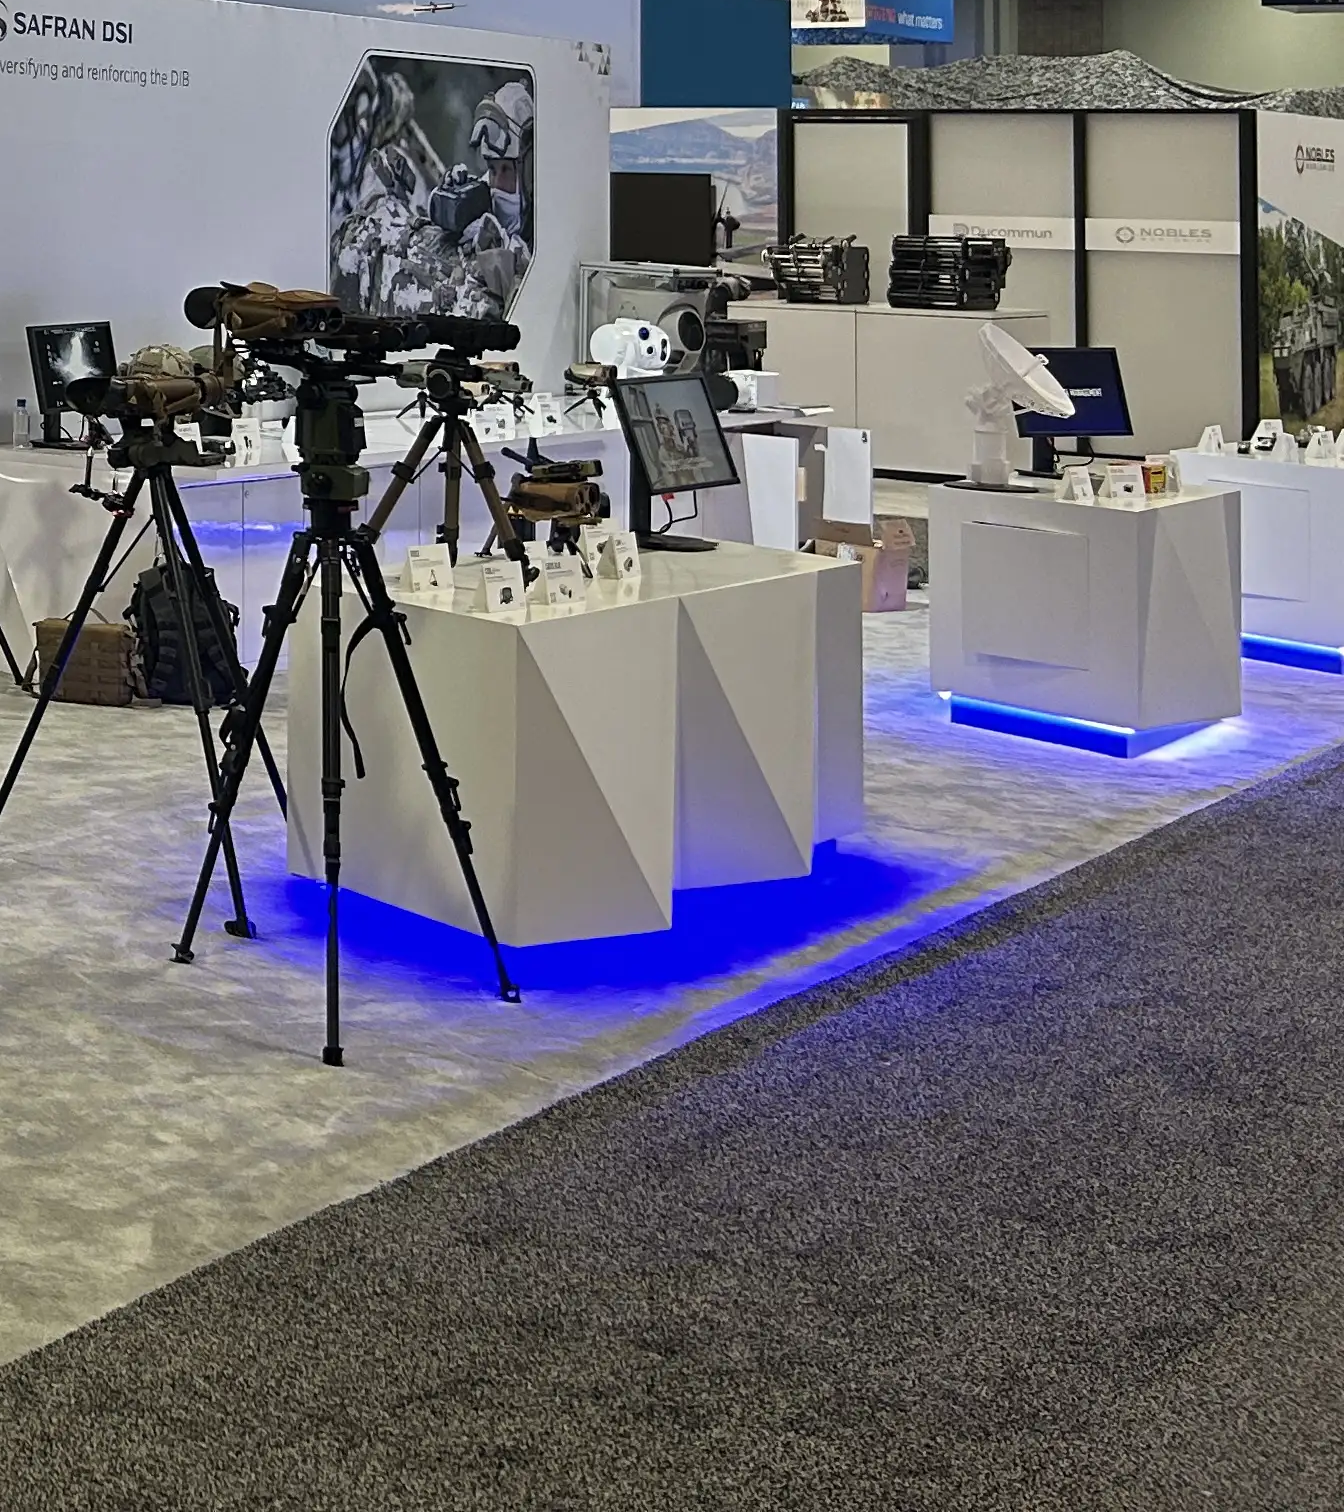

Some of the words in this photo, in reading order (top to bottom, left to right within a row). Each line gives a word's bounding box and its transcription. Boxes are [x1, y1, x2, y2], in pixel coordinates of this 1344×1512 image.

[13, 11, 95, 40] SAFRAN
[102, 20, 133, 44] DSI
[61, 62, 84, 80] and
[87, 63, 147, 87] reinforcing
[150, 68, 168, 85] the
[170, 70, 190, 87] DIB
[1140, 228, 1212, 239] NOBLES
